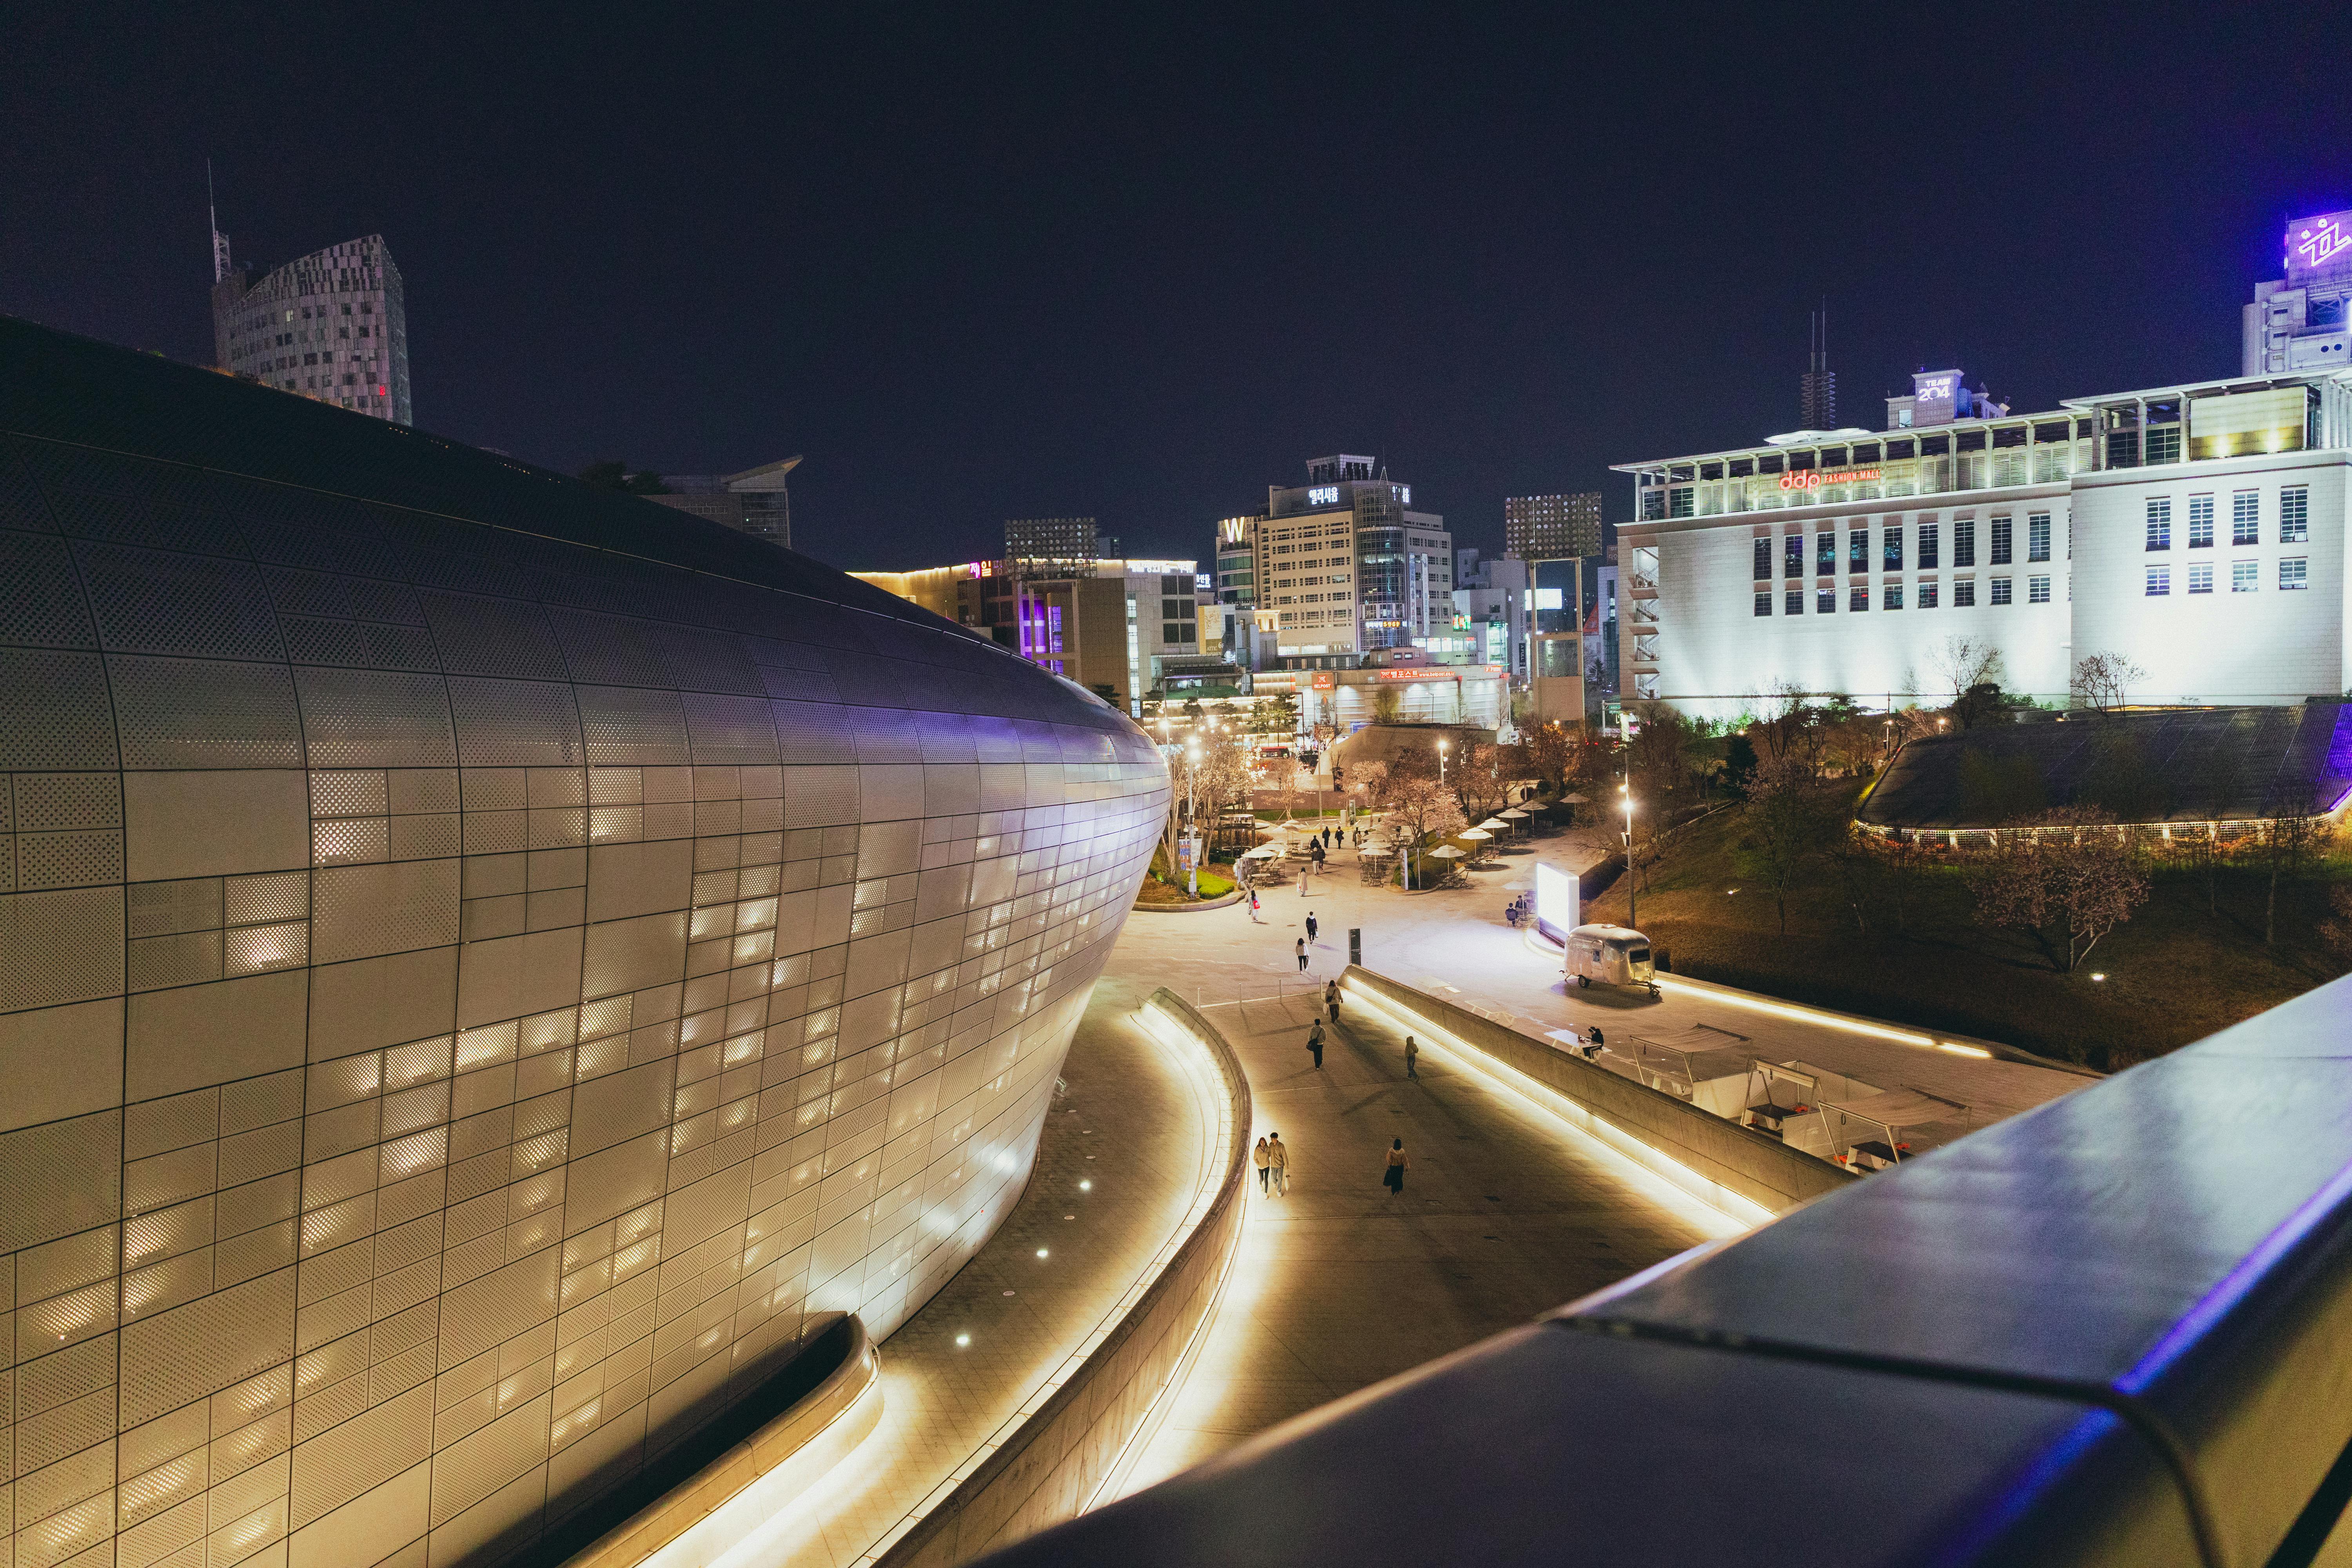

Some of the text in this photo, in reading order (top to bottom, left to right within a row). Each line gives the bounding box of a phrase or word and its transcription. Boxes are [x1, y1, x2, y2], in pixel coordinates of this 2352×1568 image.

[1926, 378, 1950, 387] TEAM
[1919, 385, 1950, 401] 204
[1779, 469, 1880, 494] ddp FASHION MALL
[1224, 516, 1245, 542] W
